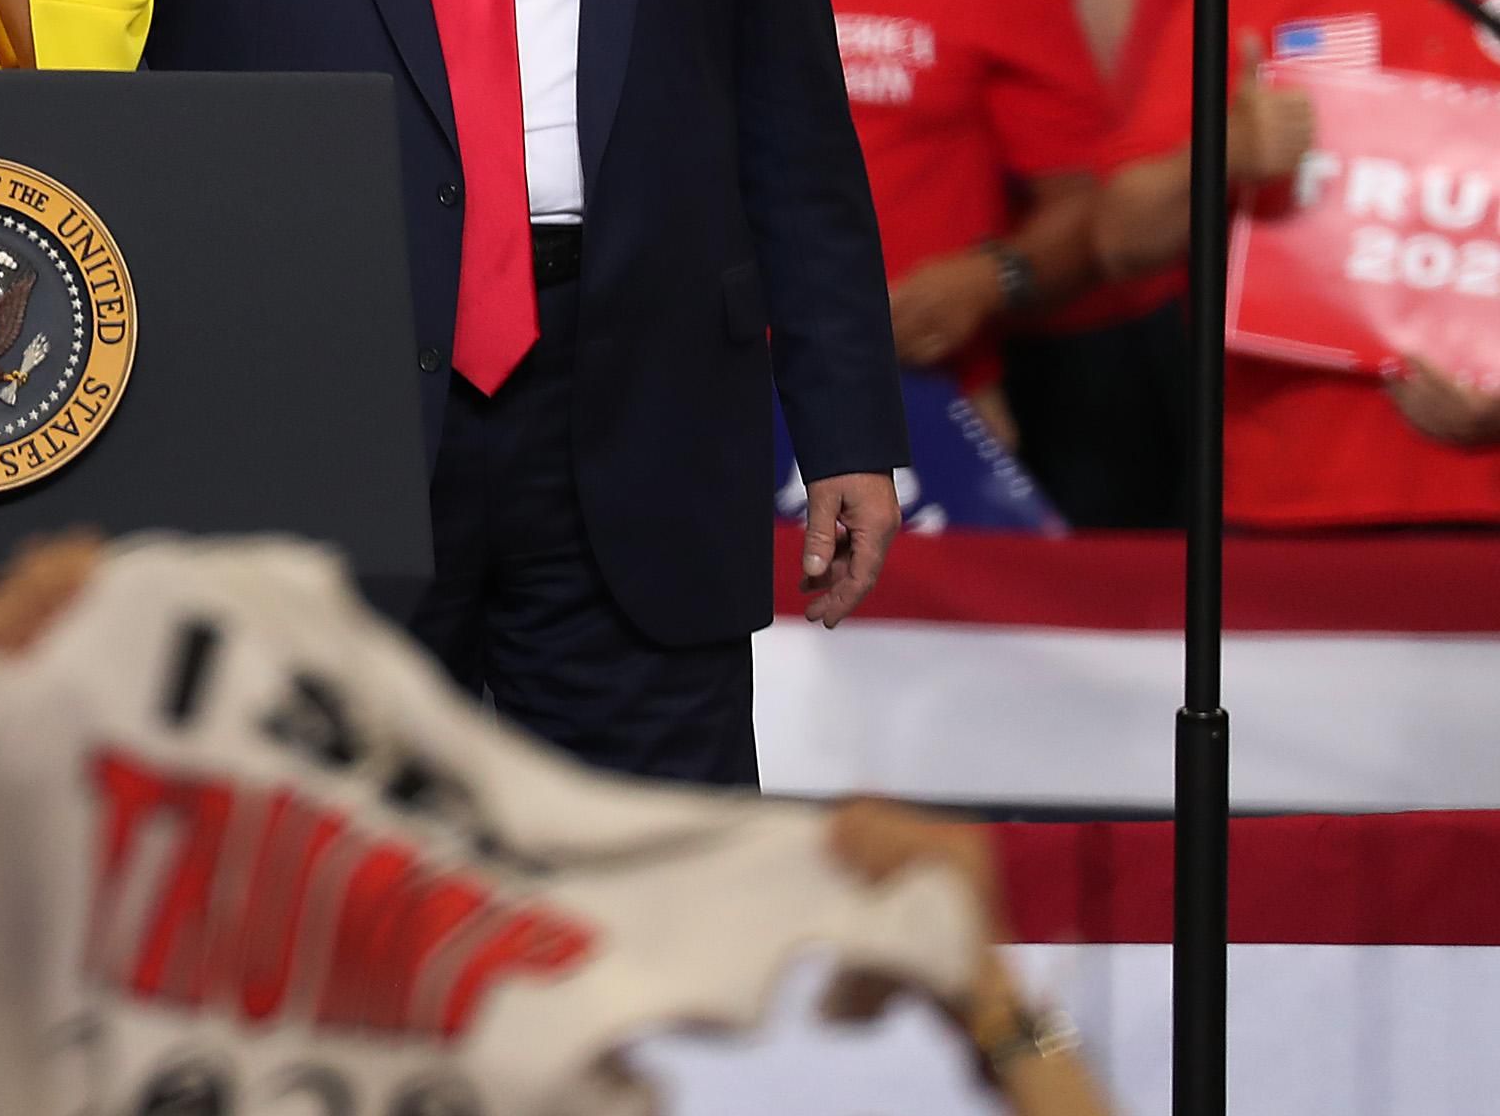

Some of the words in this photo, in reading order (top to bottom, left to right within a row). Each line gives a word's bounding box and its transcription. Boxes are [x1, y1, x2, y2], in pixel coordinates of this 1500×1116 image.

[8, 179, 50, 213] THE
[56, 208, 126, 345] UNITED
[85, 739, 605, 1046] TRUMP
